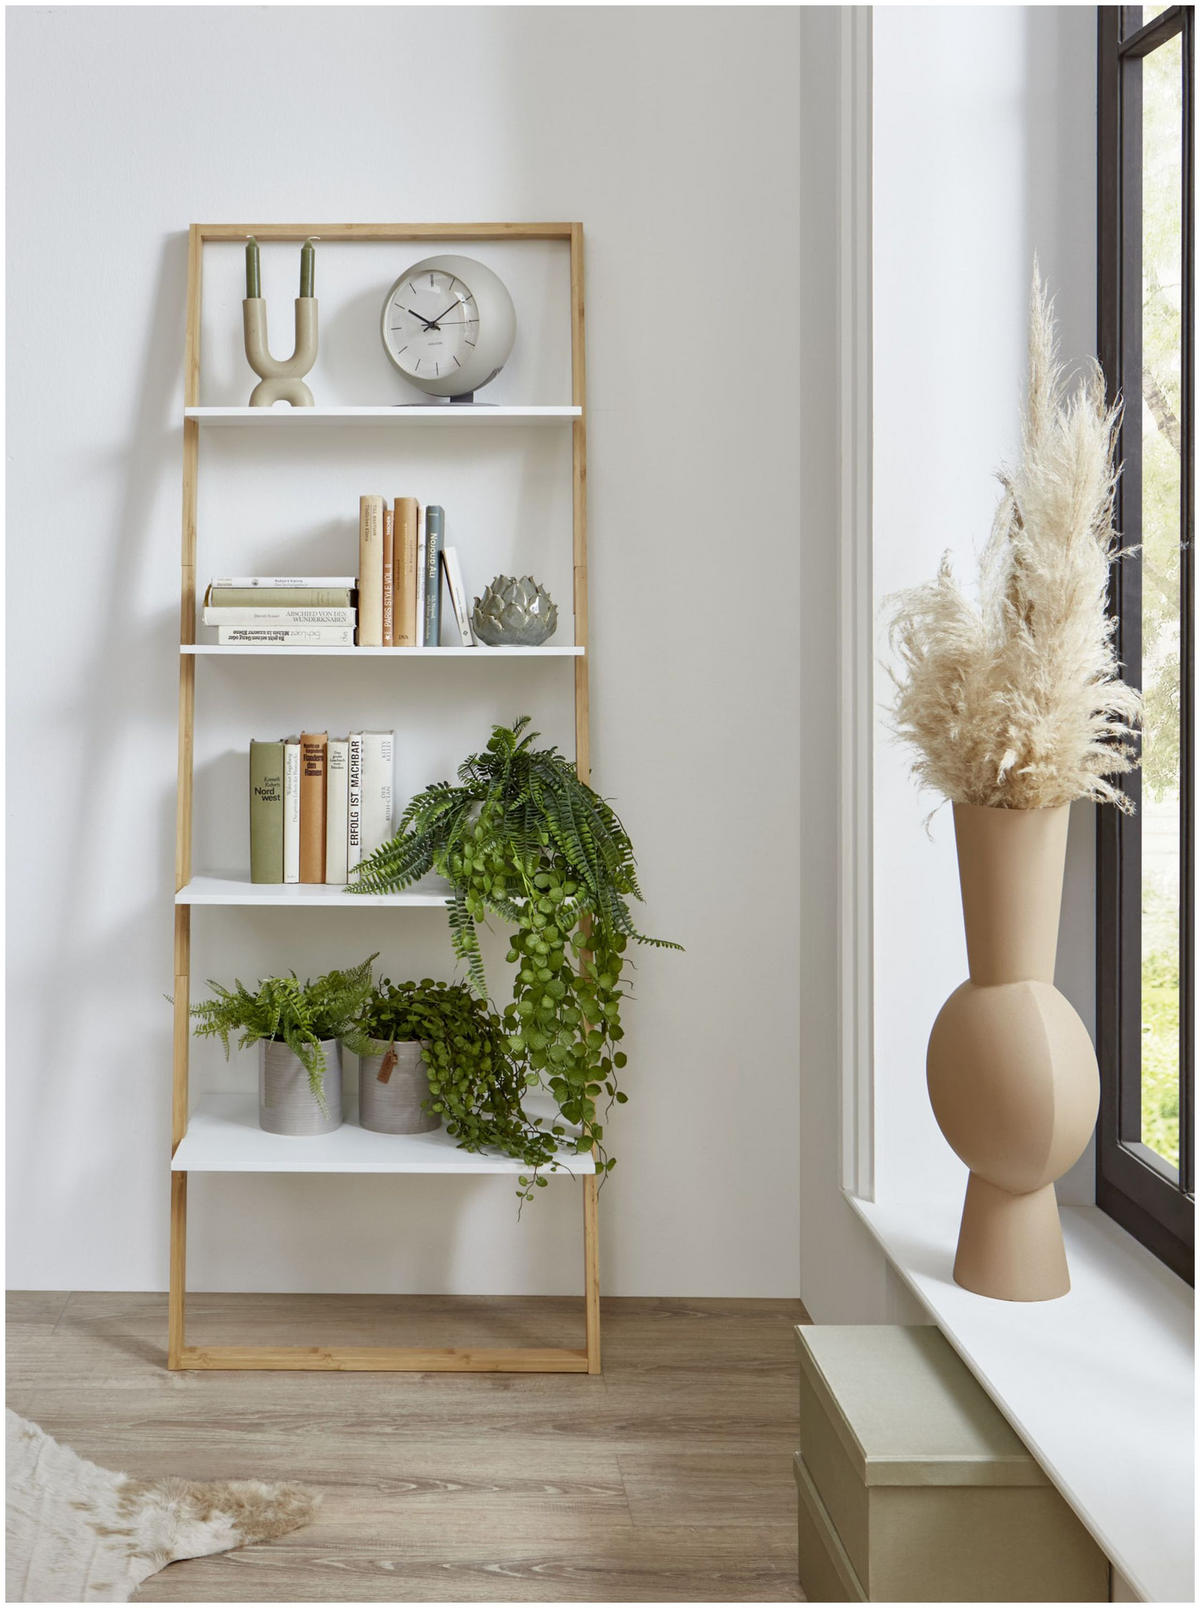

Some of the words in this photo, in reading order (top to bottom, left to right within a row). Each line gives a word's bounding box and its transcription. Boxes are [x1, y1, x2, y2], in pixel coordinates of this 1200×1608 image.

[383, 585, 393, 607] STYLE
[383, 608, 393, 627] PARIS
[350, 740, 360, 788] MACHBAR
[254, 786, 275, 795] Nord
[350, 792, 360, 807] IST
[350, 811, 360, 846] ERFOLG
